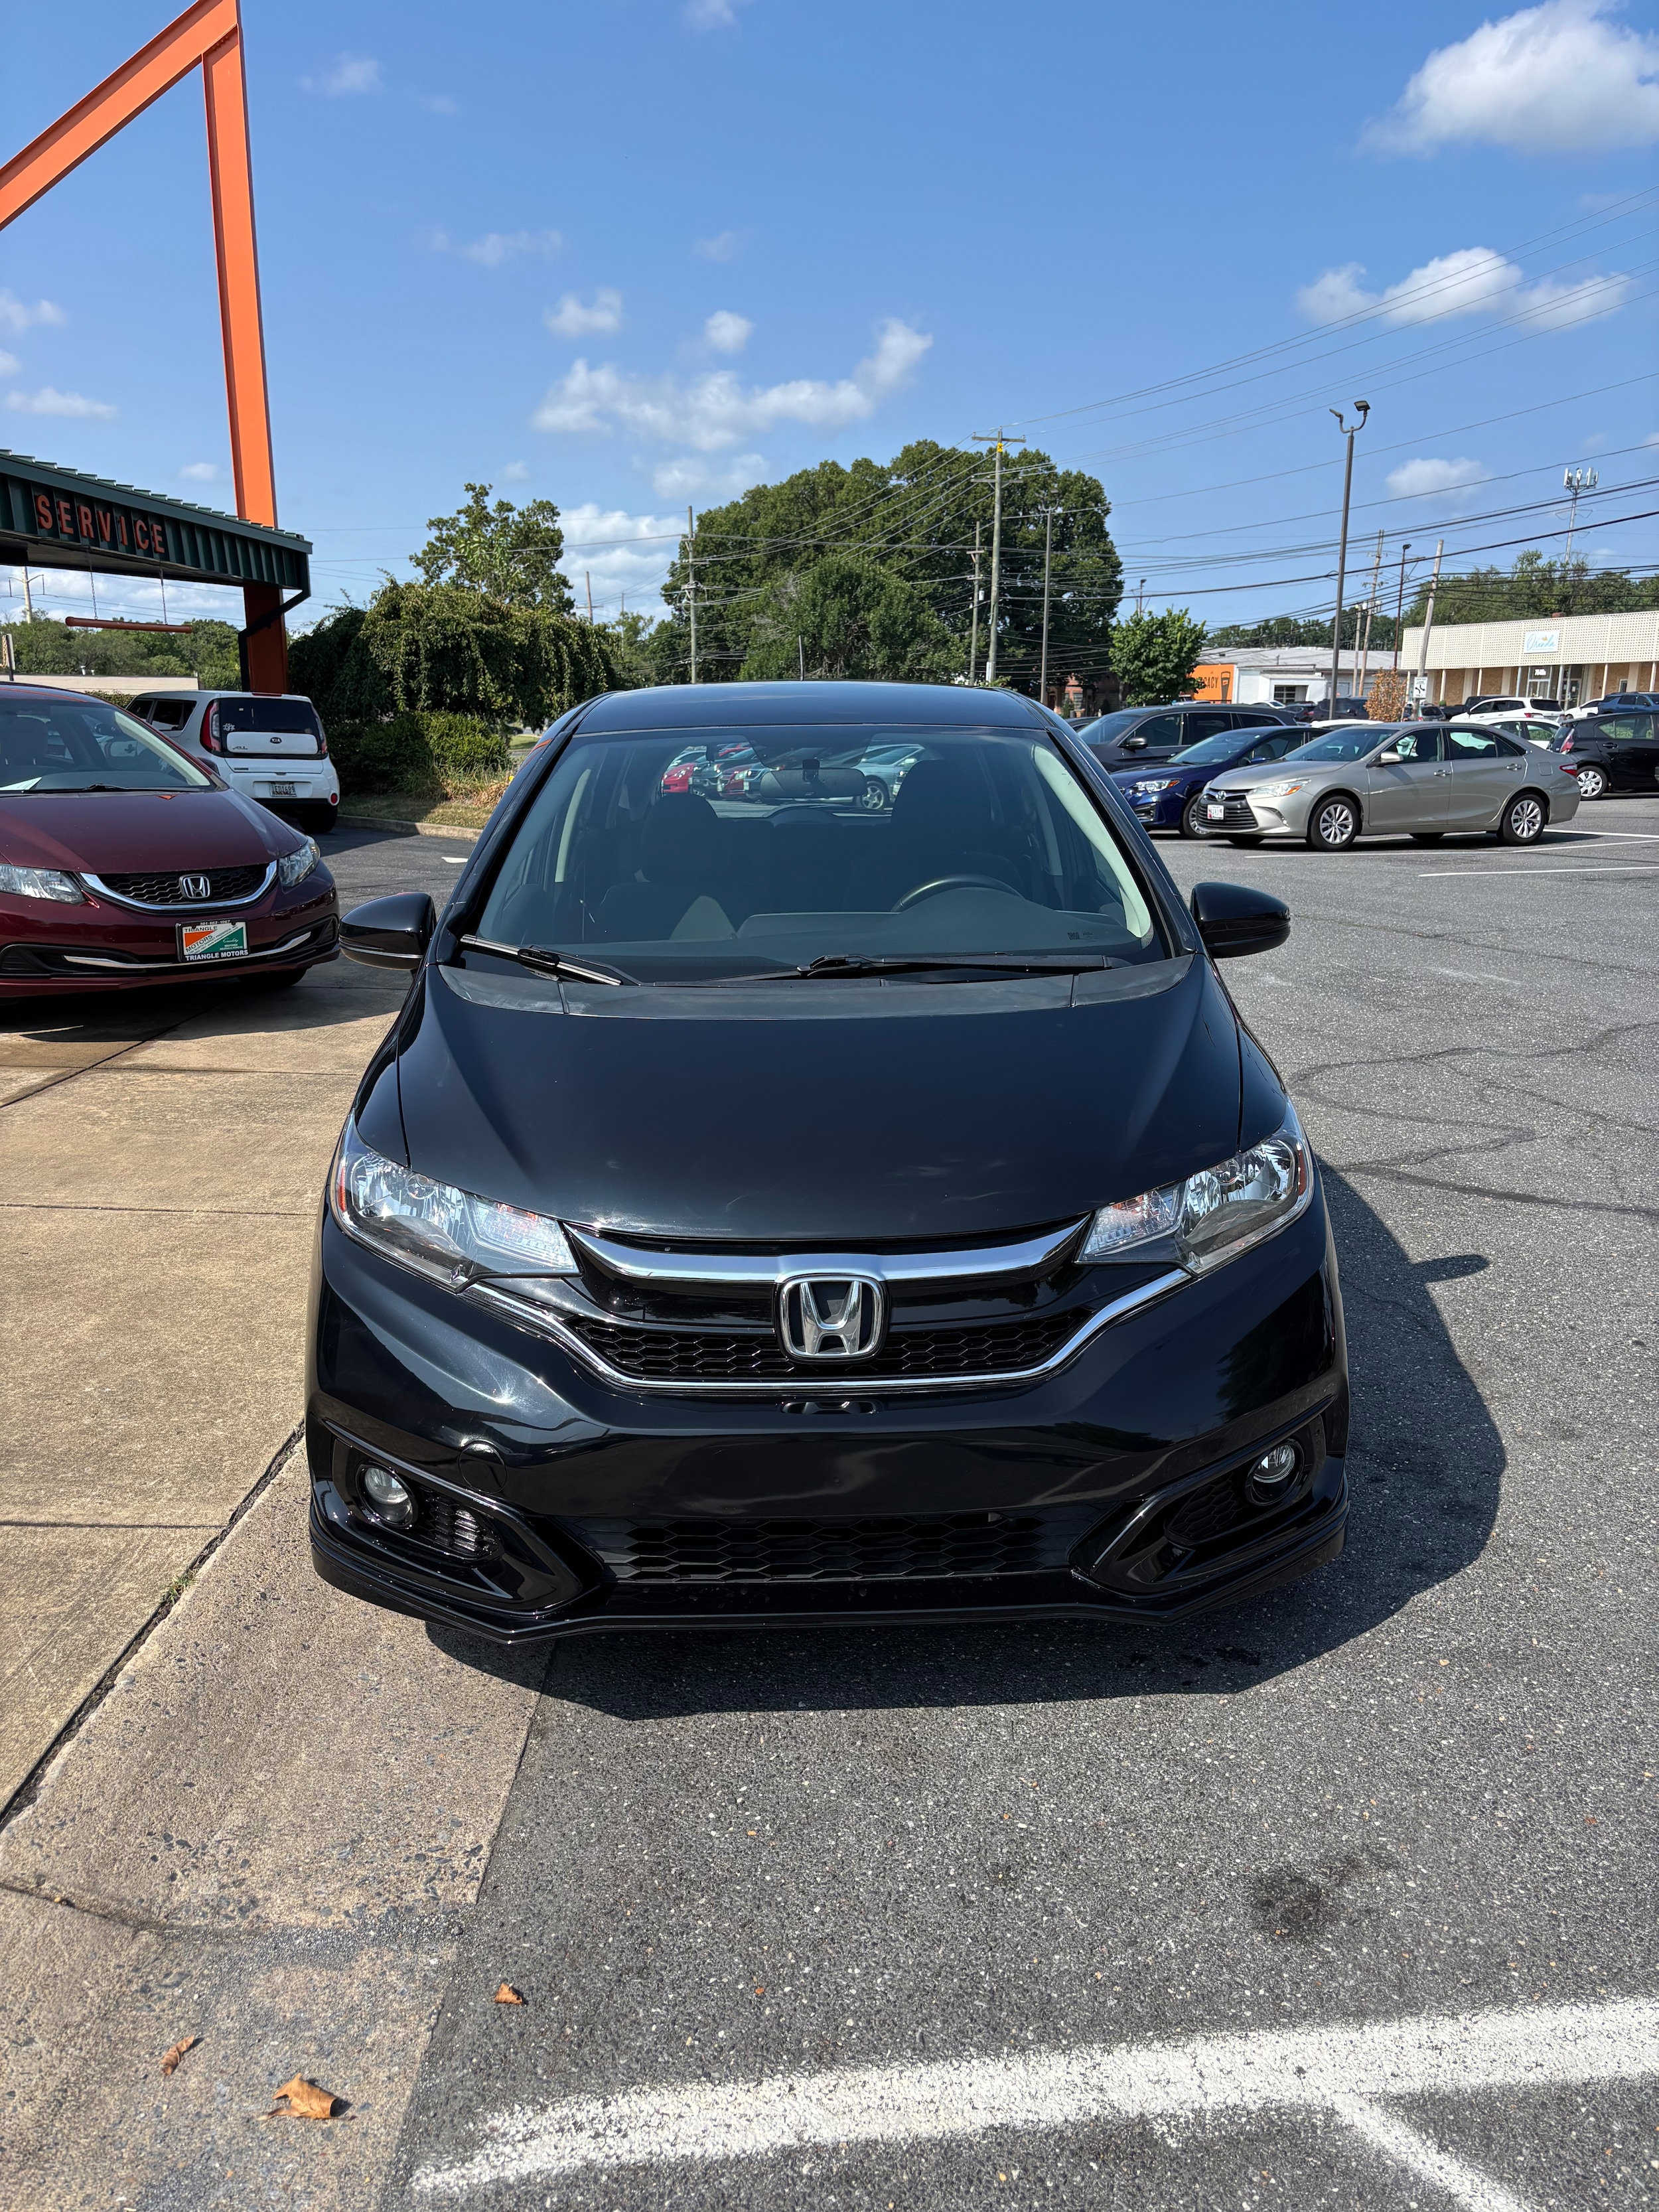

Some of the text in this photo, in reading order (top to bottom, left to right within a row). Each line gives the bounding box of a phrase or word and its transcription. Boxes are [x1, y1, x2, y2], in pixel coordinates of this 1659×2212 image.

[36, 494, 165, 553] SERVICE
[186, 934, 213, 953] MOTORS
[185, 952, 220, 961] TRIANGLE
